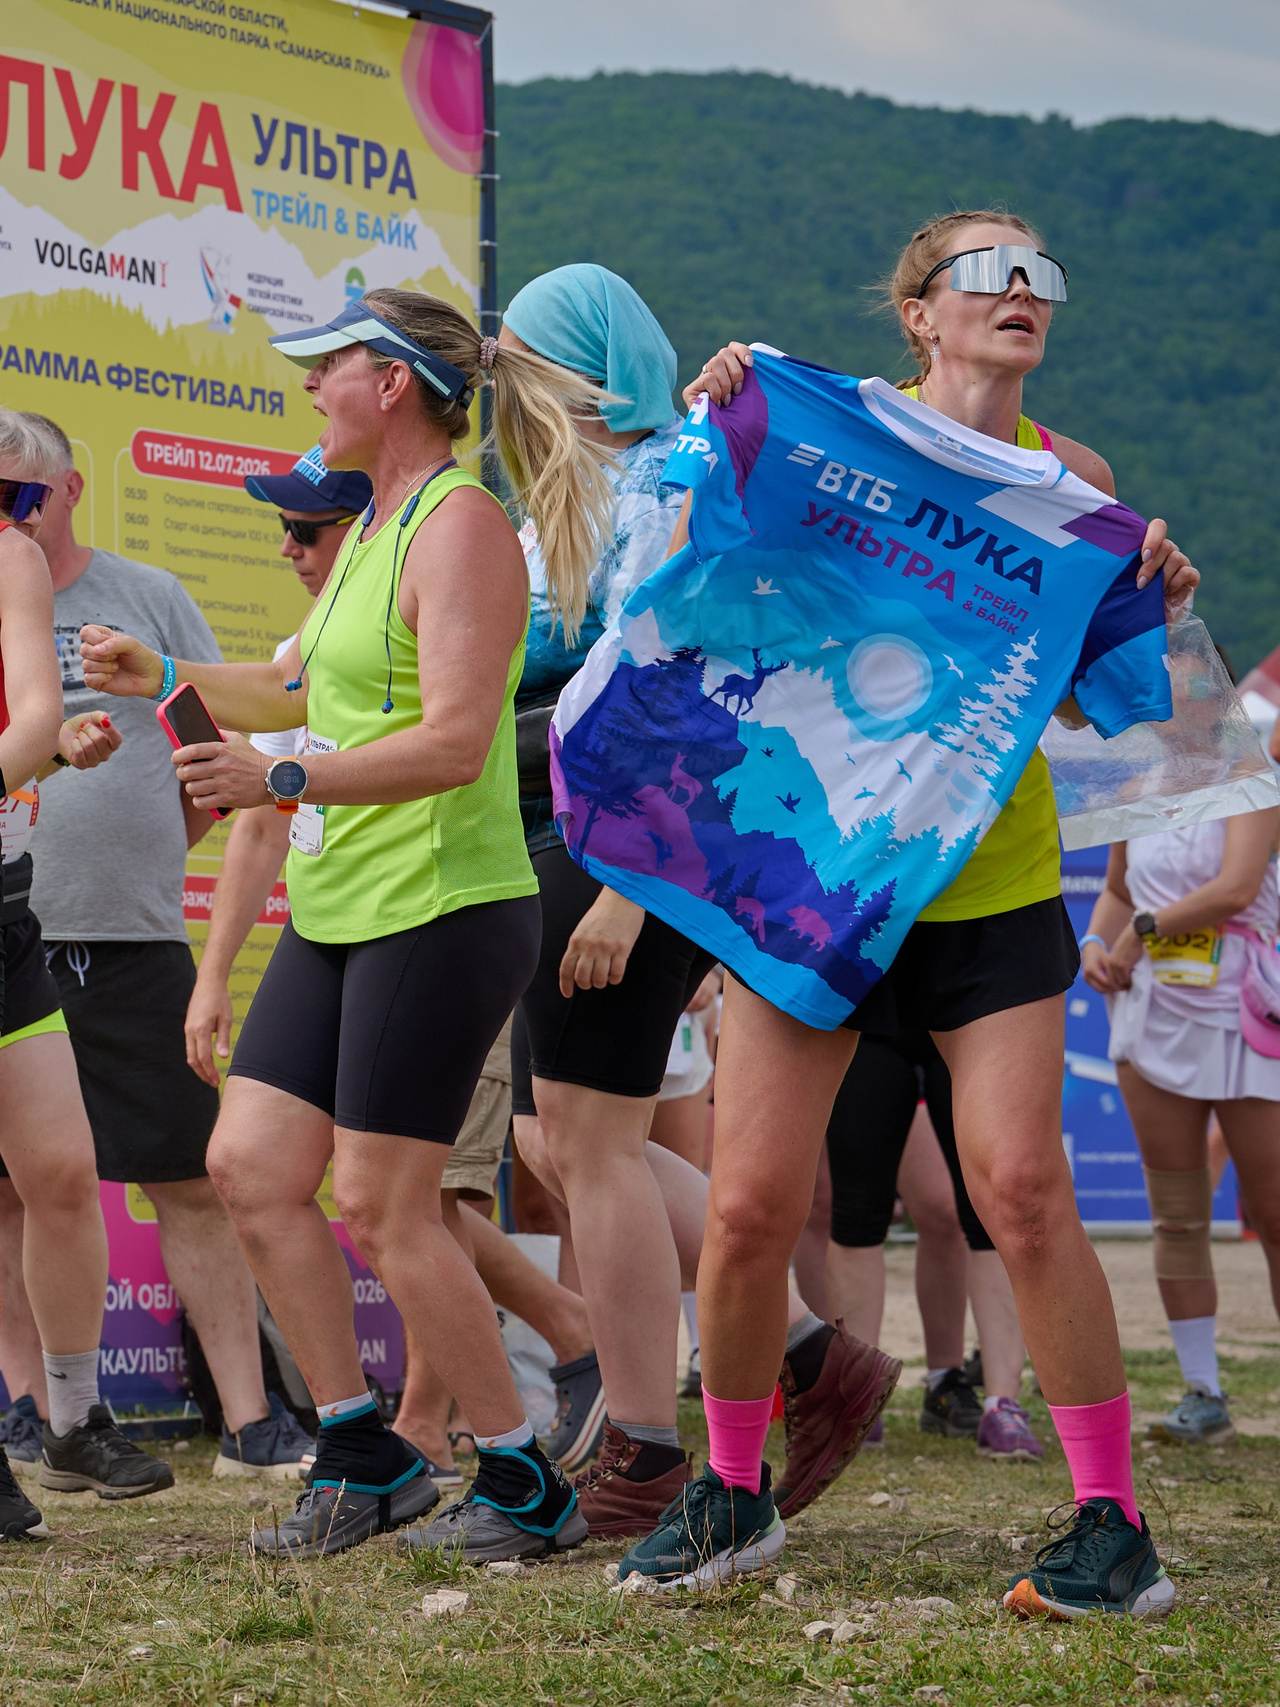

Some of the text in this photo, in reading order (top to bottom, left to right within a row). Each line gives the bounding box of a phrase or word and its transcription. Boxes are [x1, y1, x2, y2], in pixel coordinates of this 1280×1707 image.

[228, 5, 288, 34] ОБЛАСТИ,
[116, 4, 227, 39] НАЦИОНАЛЬНОГО
[230, 28, 270, 50] ПАРКА
[274, 40, 352, 70] «САМАРСКАЯ
[355, 59, 391, 79] ЛУКА»
[251, 113, 417, 200] УЛЬТРА
[251, 189, 418, 251] ТРЕЙЛ & БАЙК
[35, 238, 156, 286] VOLGAMAN
[106, 363, 285, 417] ФЕСТИВАЛЯ
[144, 440, 270, 476] ТРЕЙЛ 12.07.2026
[164, 493, 252, 515] Открытие стартового
[164, 518, 188, 533] Старт
[190, 525, 200, 533] на
[202, 525, 246, 539] дистанции
[815, 461, 1043, 596] ВТБ ЛУКА
[164, 542, 229, 562] Торжественное
[231, 552, 269, 567] открытие
[800, 501, 956, 602] УЛЬТРА
[962, 600, 1020, 635] & БАЙК
[974, 584, 1029, 622] ТРЕЙЛ
[211, 626, 247, 638] станции
[157, 657, 174, 702] УЧАСТНИ
[353, 1280, 386, 1304] 026
